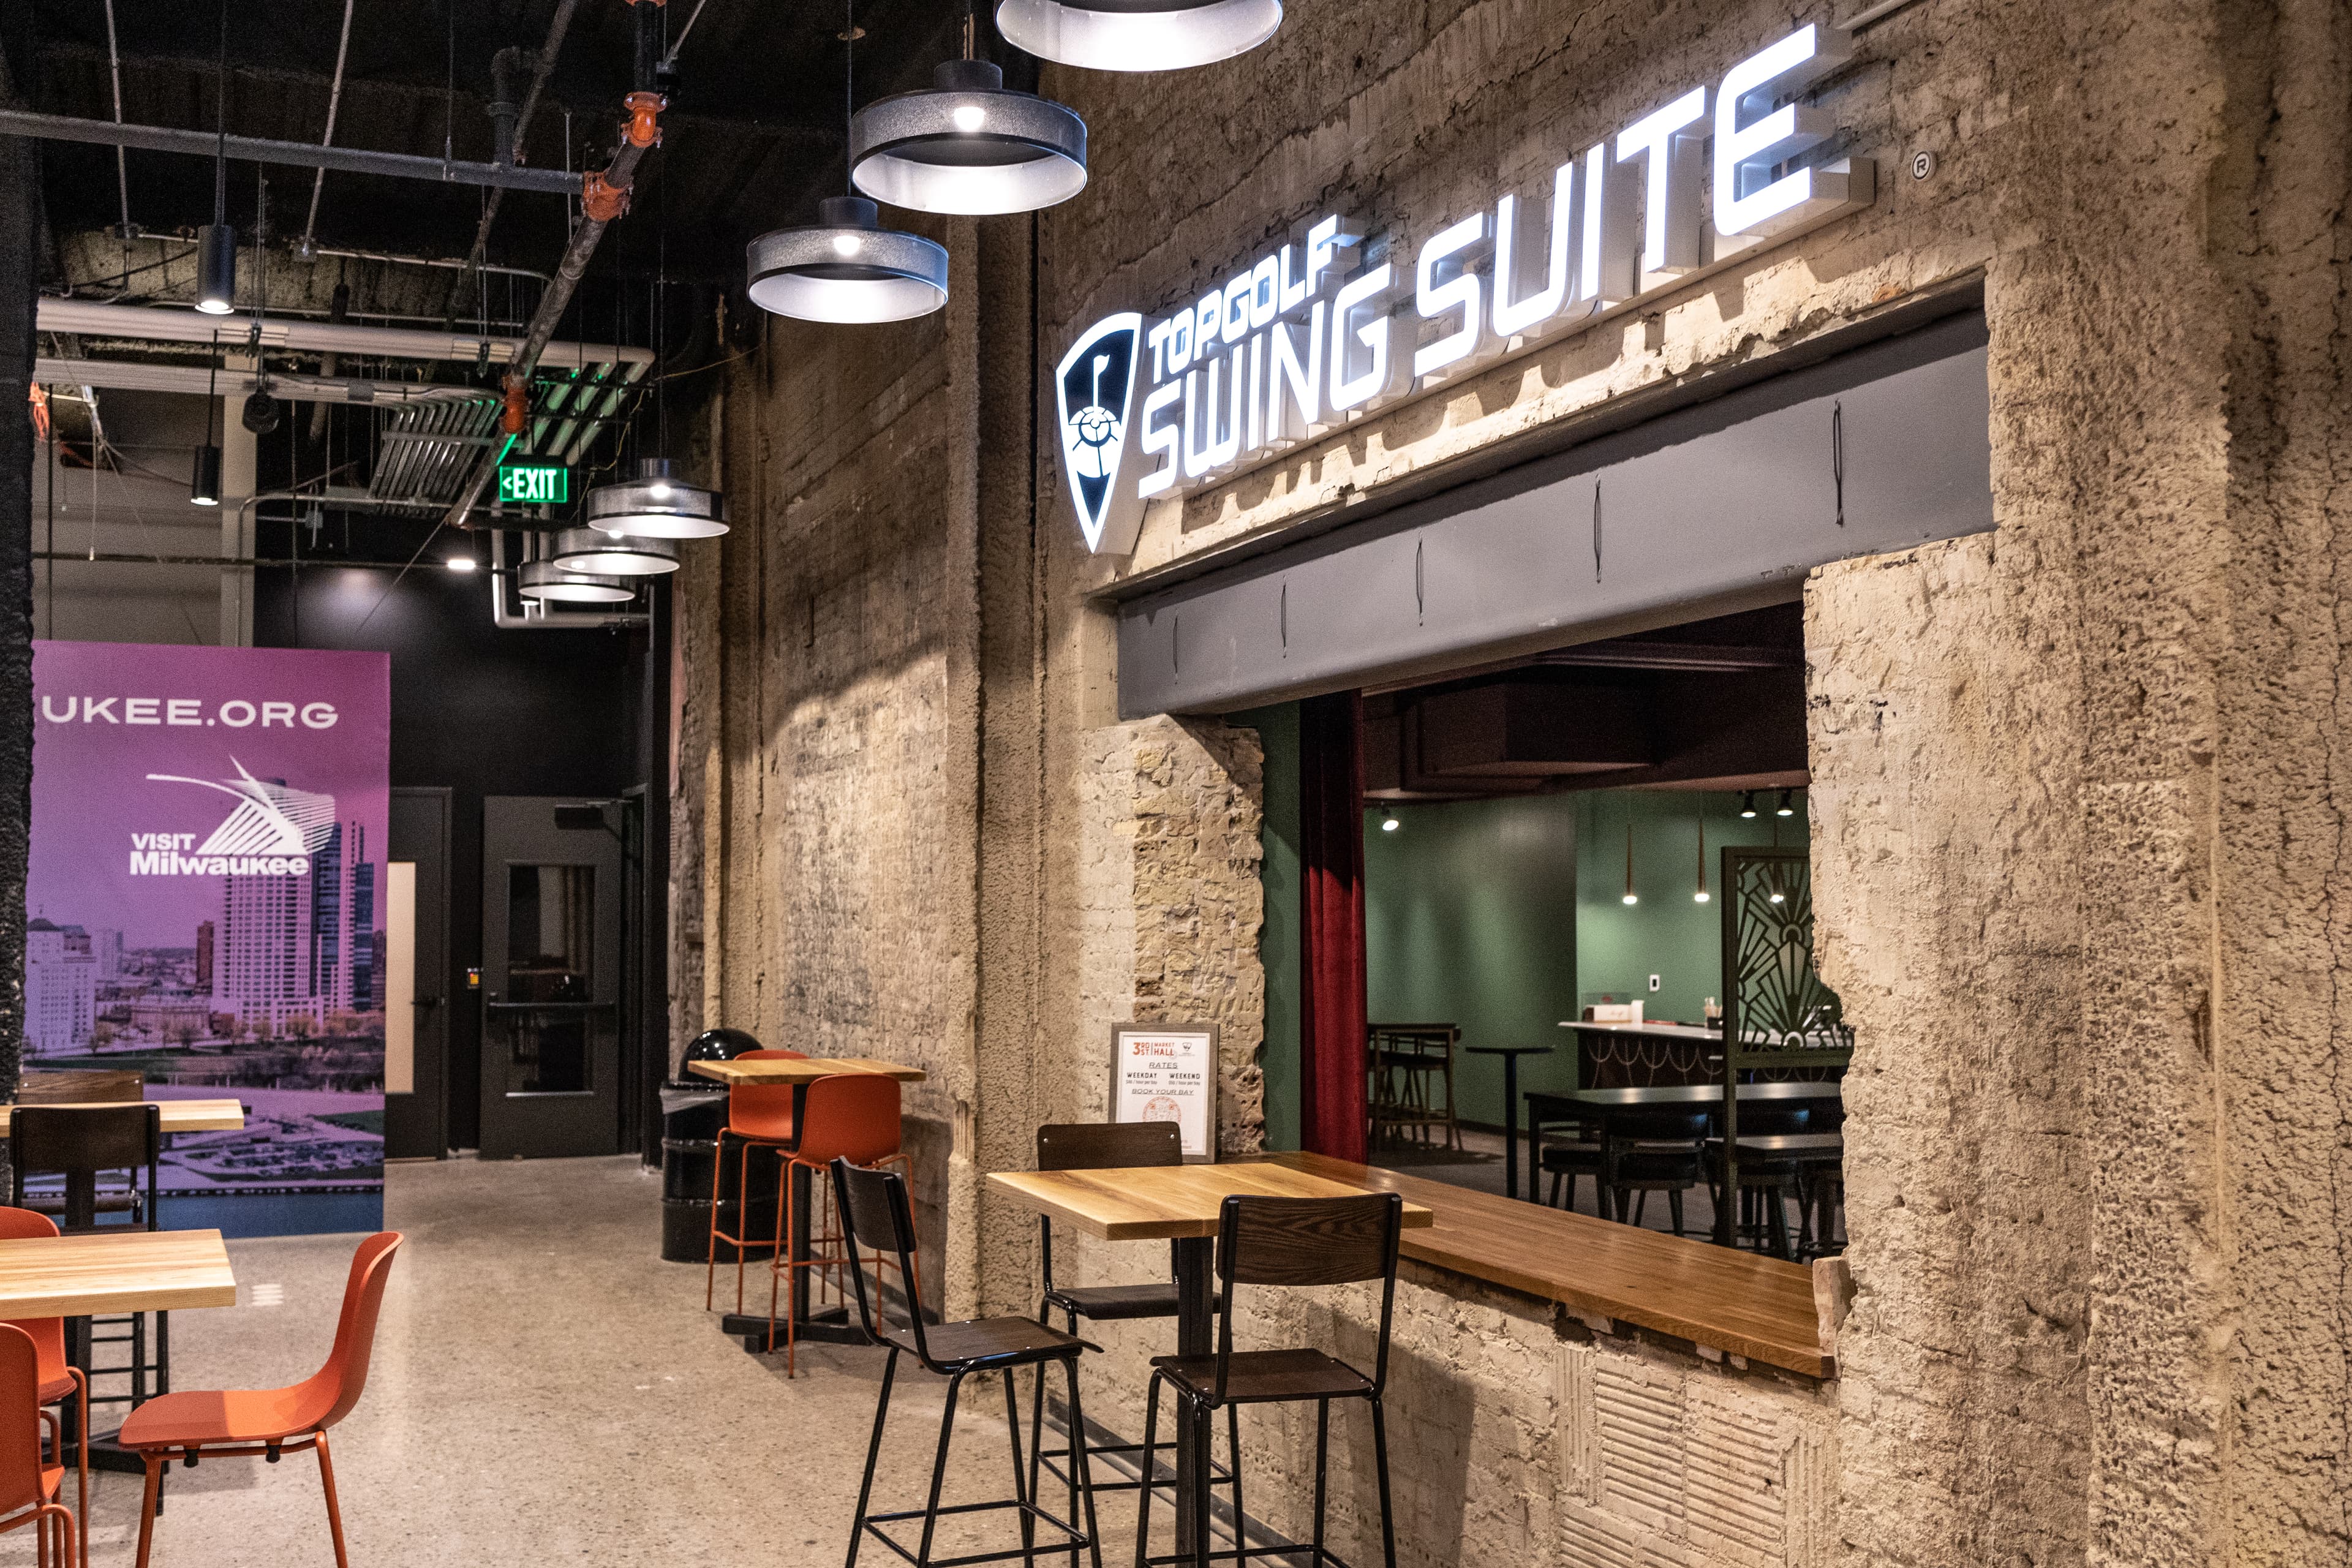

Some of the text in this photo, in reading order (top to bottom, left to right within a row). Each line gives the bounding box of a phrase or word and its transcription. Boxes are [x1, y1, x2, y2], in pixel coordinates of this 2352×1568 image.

[1138, 262, 1391, 499] SWING
[1414, 22, 1815, 377] SUITE
[1148, 213, 1338, 384] TOPGOLF
[513, 468, 557, 500] EXIT
[41, 695, 339, 729] UKEE.ORG
[131, 833, 196, 851] VISIT
[129, 851, 309, 876] Milwaukee
